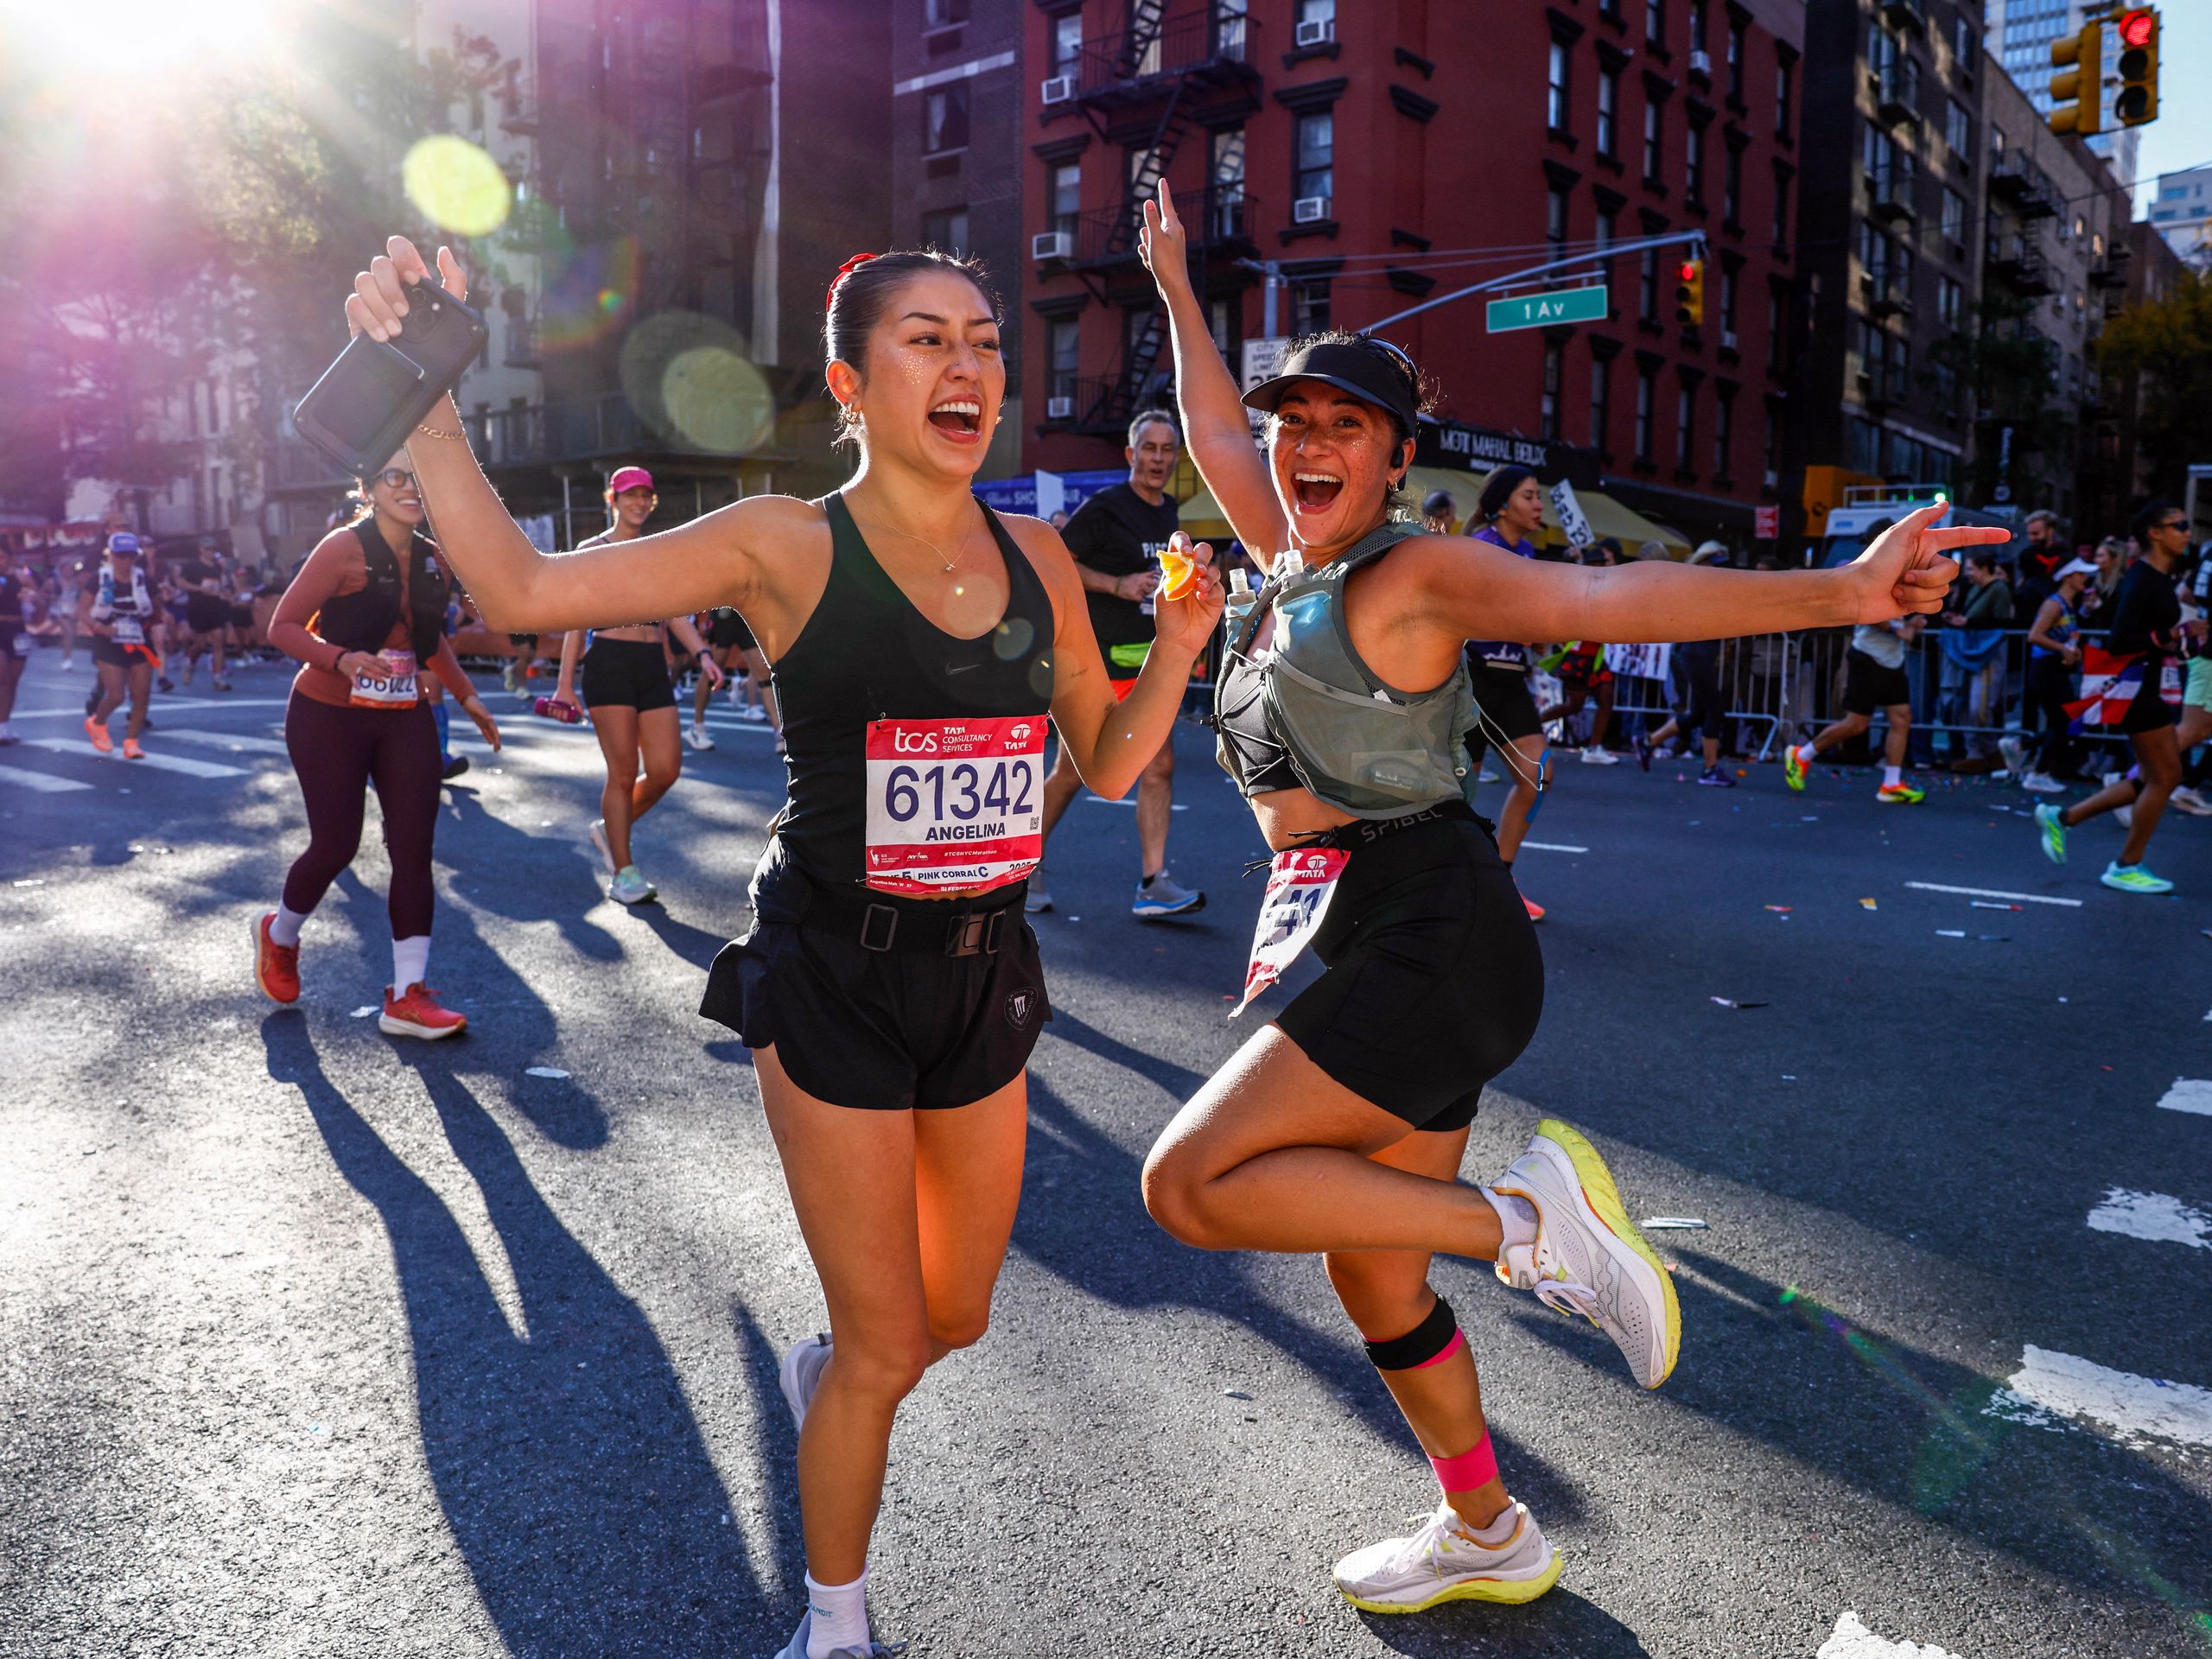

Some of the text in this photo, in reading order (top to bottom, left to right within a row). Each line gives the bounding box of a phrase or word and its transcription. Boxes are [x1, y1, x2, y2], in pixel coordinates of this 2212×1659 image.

[1524, 301, 1565, 320] 1 Av
[1014, 489, 1037, 505] SHO
[894, 727, 938, 753] tcs
[943, 734, 993, 744] CONSULTANCY
[1004, 741, 1027, 750] TATA
[942, 744, 973, 753] SERVICES
[886, 760, 1033, 822] 61342
[925, 823, 1006, 842] ANGELINA
[918, 871, 940, 880] PINK
[942, 868, 977, 878] CORRAL
[978, 866, 988, 878] C
